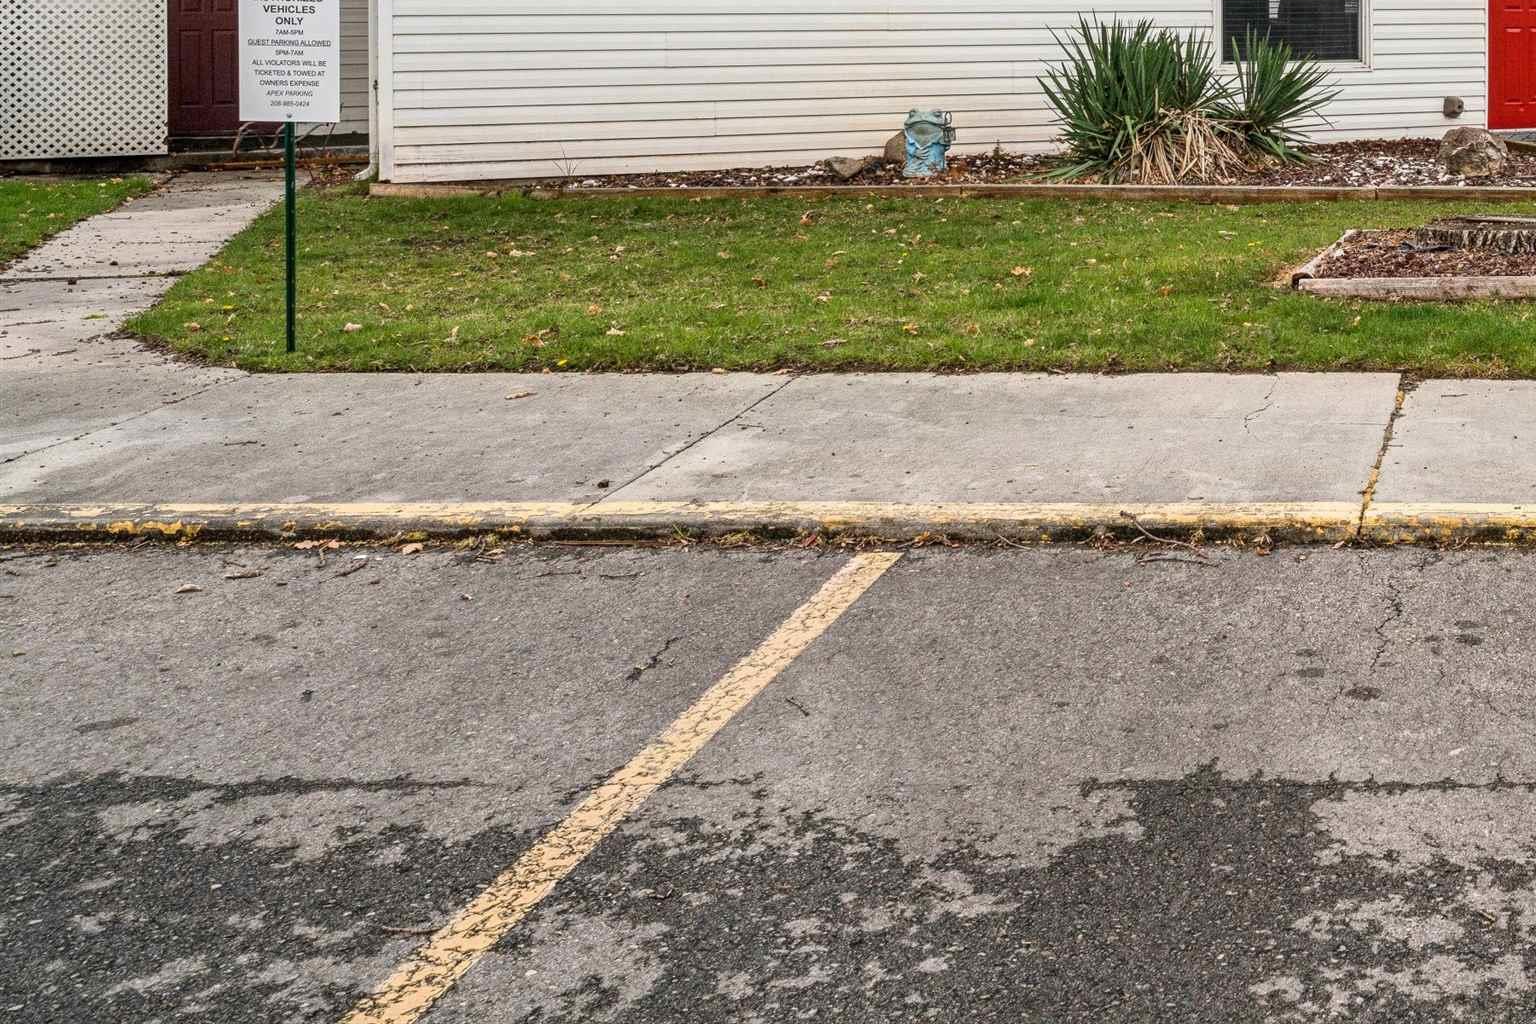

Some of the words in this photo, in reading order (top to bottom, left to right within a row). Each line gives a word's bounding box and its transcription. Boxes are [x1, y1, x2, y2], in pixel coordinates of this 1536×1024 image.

[263, 5, 316, 14] VEHICLES
[275, 16, 304, 25] ONLY
[271, 38, 299, 47] PARKING
[300, 39, 331, 47] ALLOWED
[259, 79, 288, 87] OWNERS
